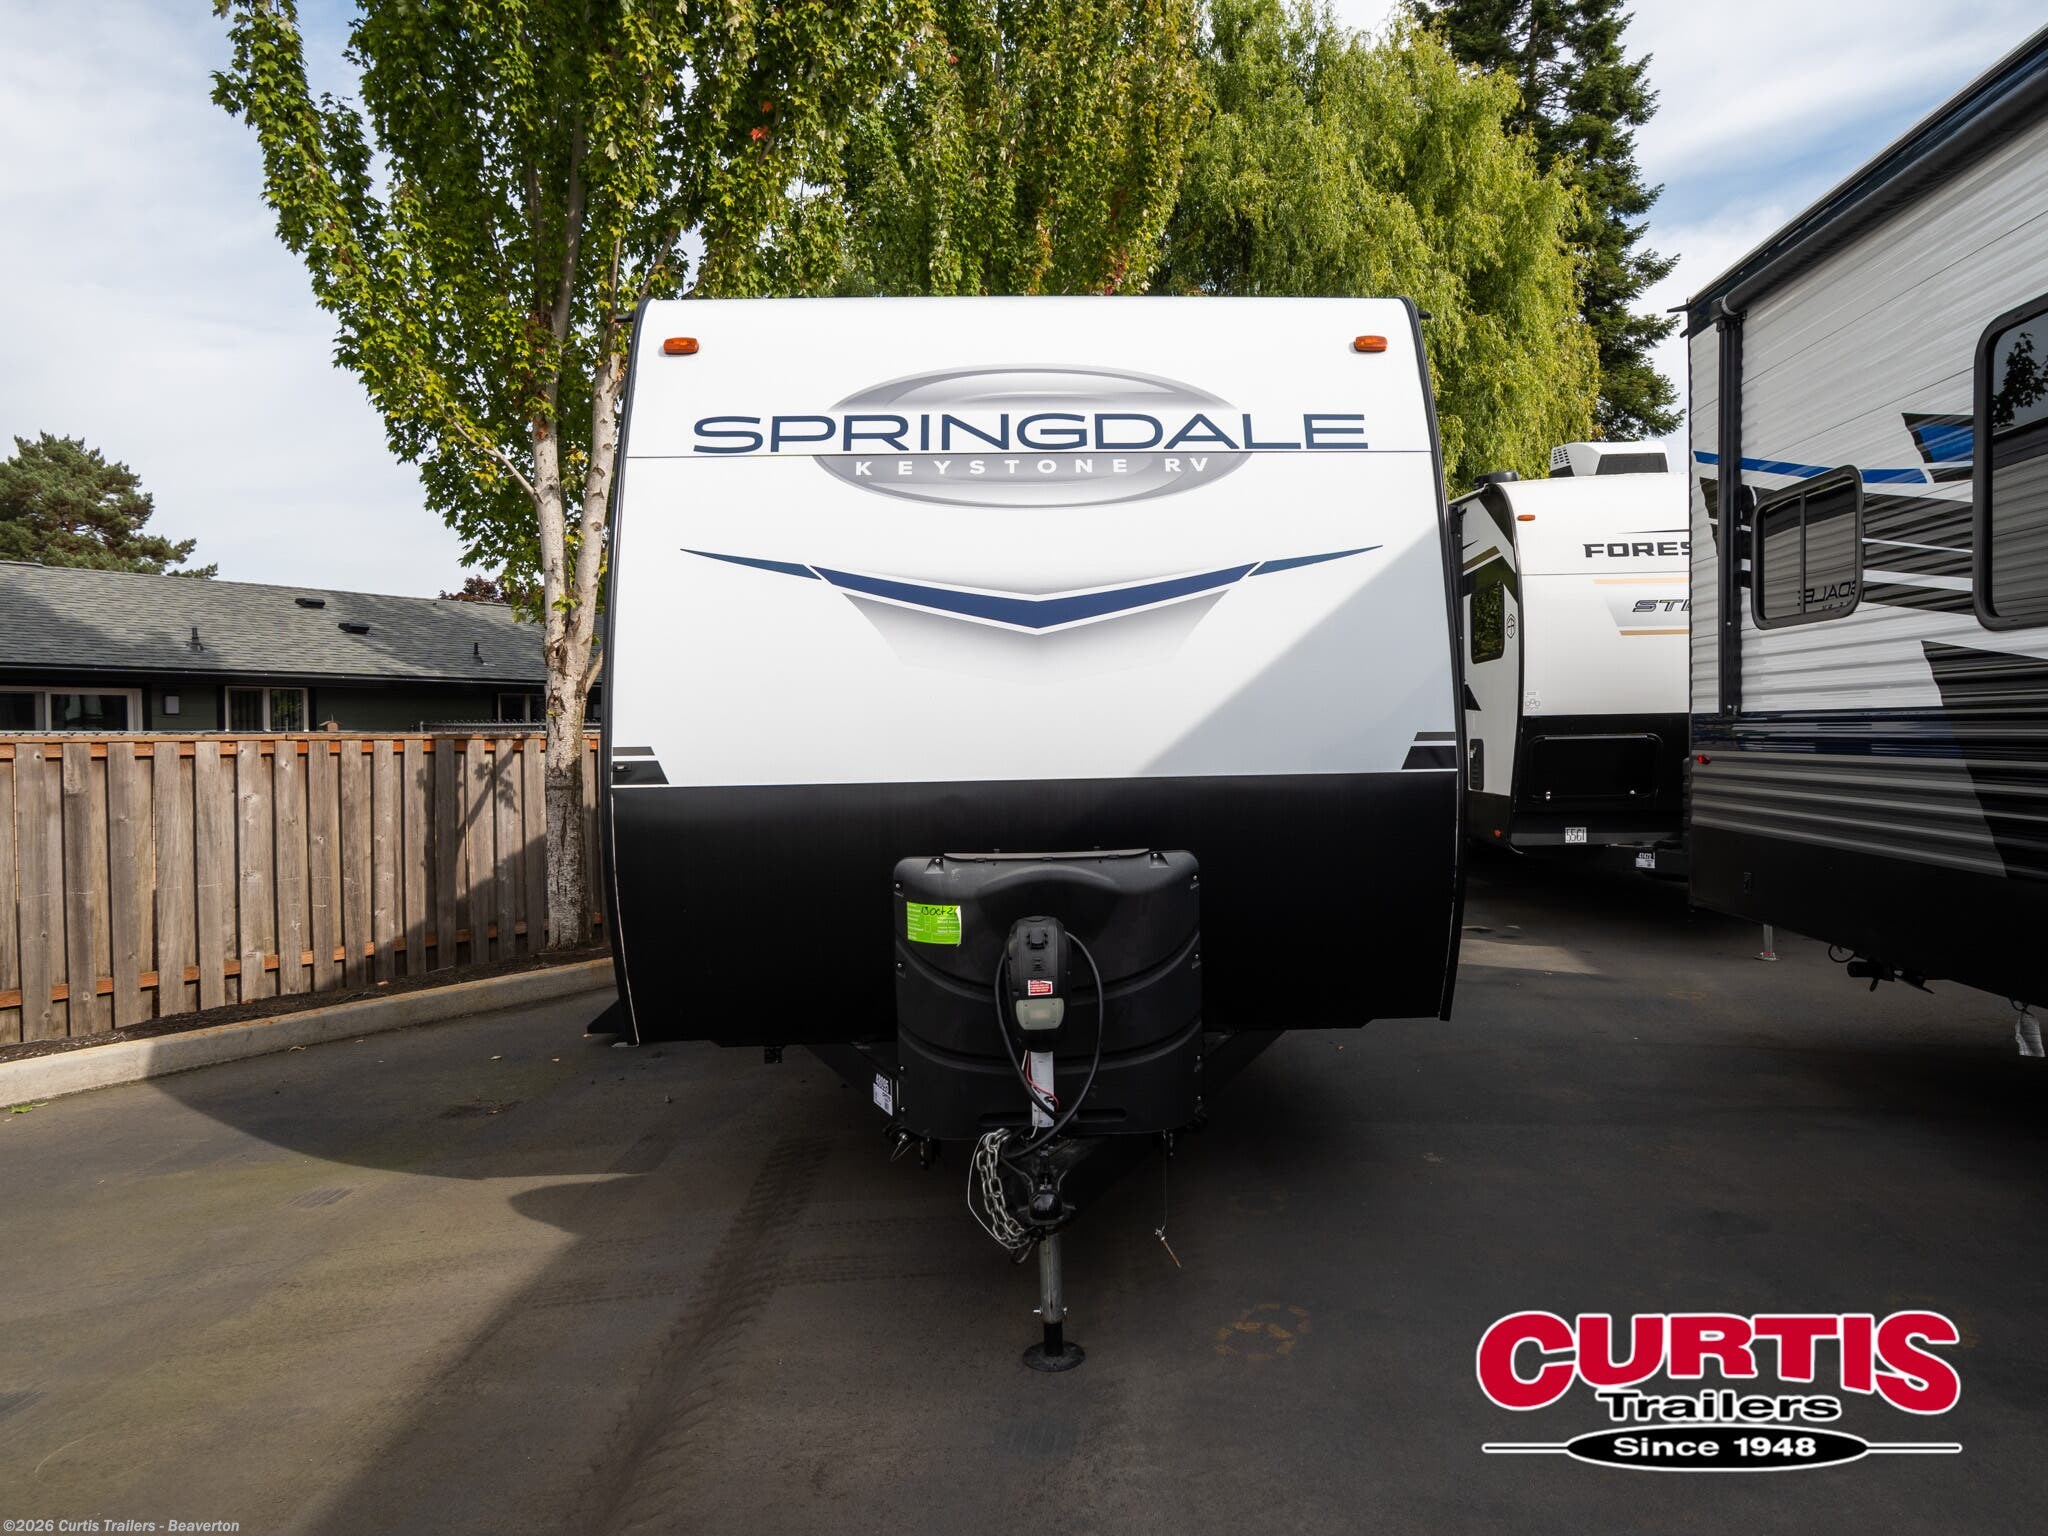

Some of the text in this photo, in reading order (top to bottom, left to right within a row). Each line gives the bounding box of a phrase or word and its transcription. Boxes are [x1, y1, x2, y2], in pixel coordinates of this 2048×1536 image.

[693, 413, 1369, 453] SPRINGDALE
[855, 457, 1210, 476] KEYSTONE RV
